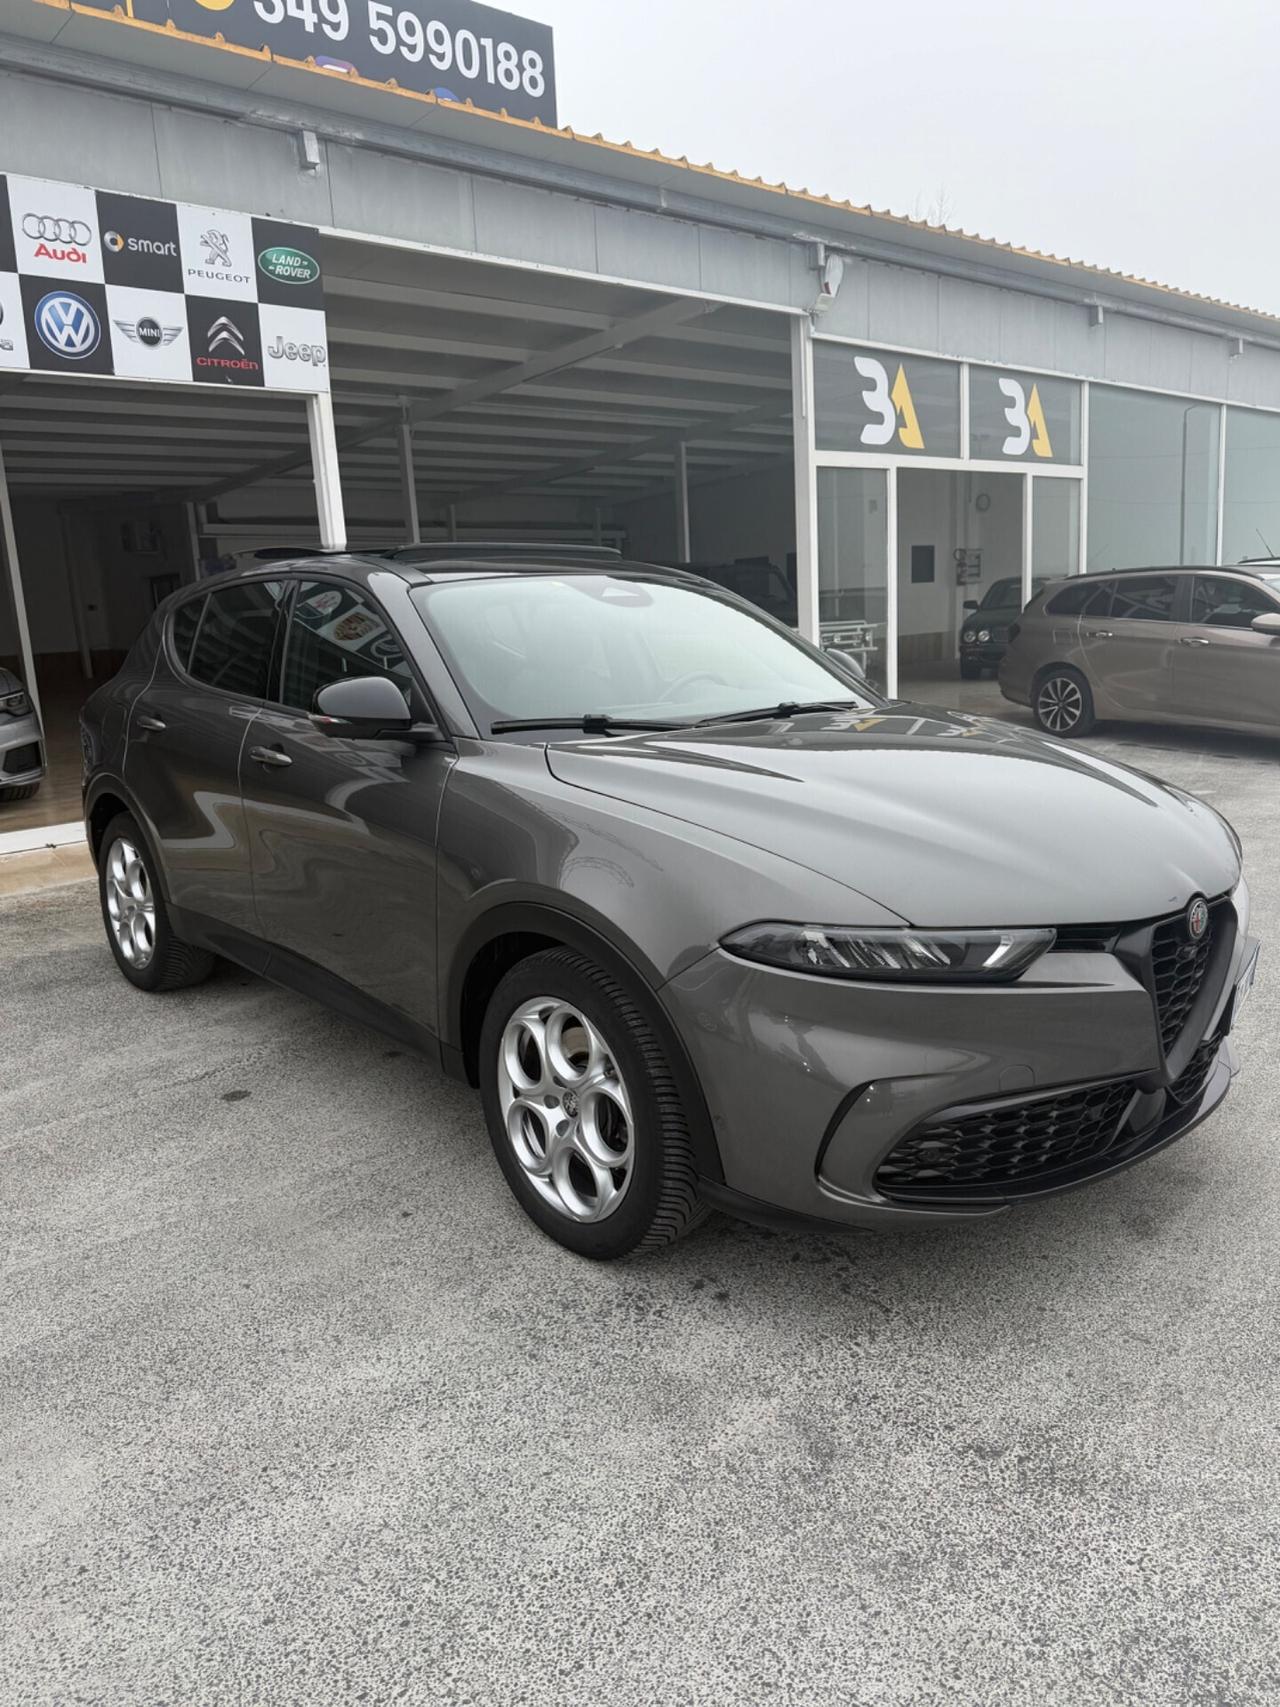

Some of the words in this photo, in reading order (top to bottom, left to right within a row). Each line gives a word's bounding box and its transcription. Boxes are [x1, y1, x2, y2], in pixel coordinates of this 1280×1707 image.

[368, 0, 546, 98] 5990188
[34, 243, 88, 264] Audi
[127, 236, 178, 257] smart
[187, 268, 251, 284] PEUGEOT
[137, 327, 161, 338] MINI
[267, 335, 327, 367] Jeep
